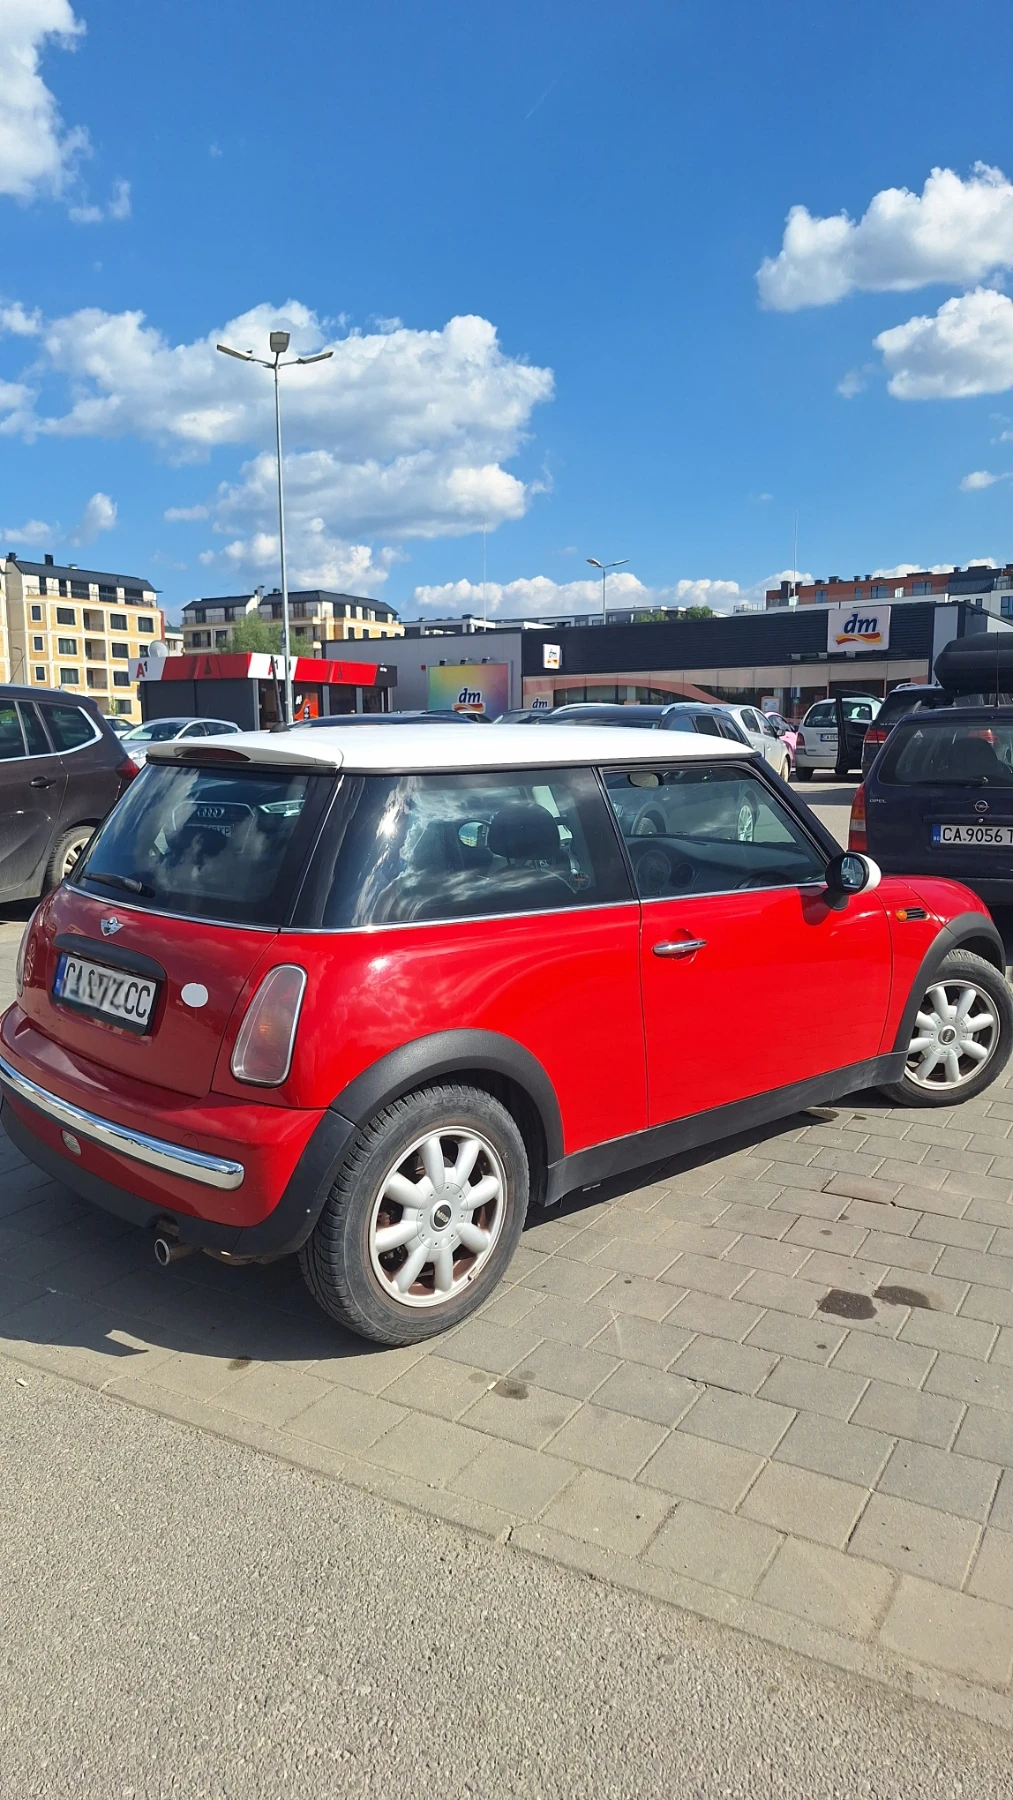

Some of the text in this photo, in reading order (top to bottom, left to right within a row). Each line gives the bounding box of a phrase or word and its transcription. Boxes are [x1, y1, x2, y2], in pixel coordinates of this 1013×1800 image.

[843, 613, 877, 634] dm
[136, 661, 148, 678] A1
[458, 687, 481, 704] dm
[532, 698, 548, 708] dm
